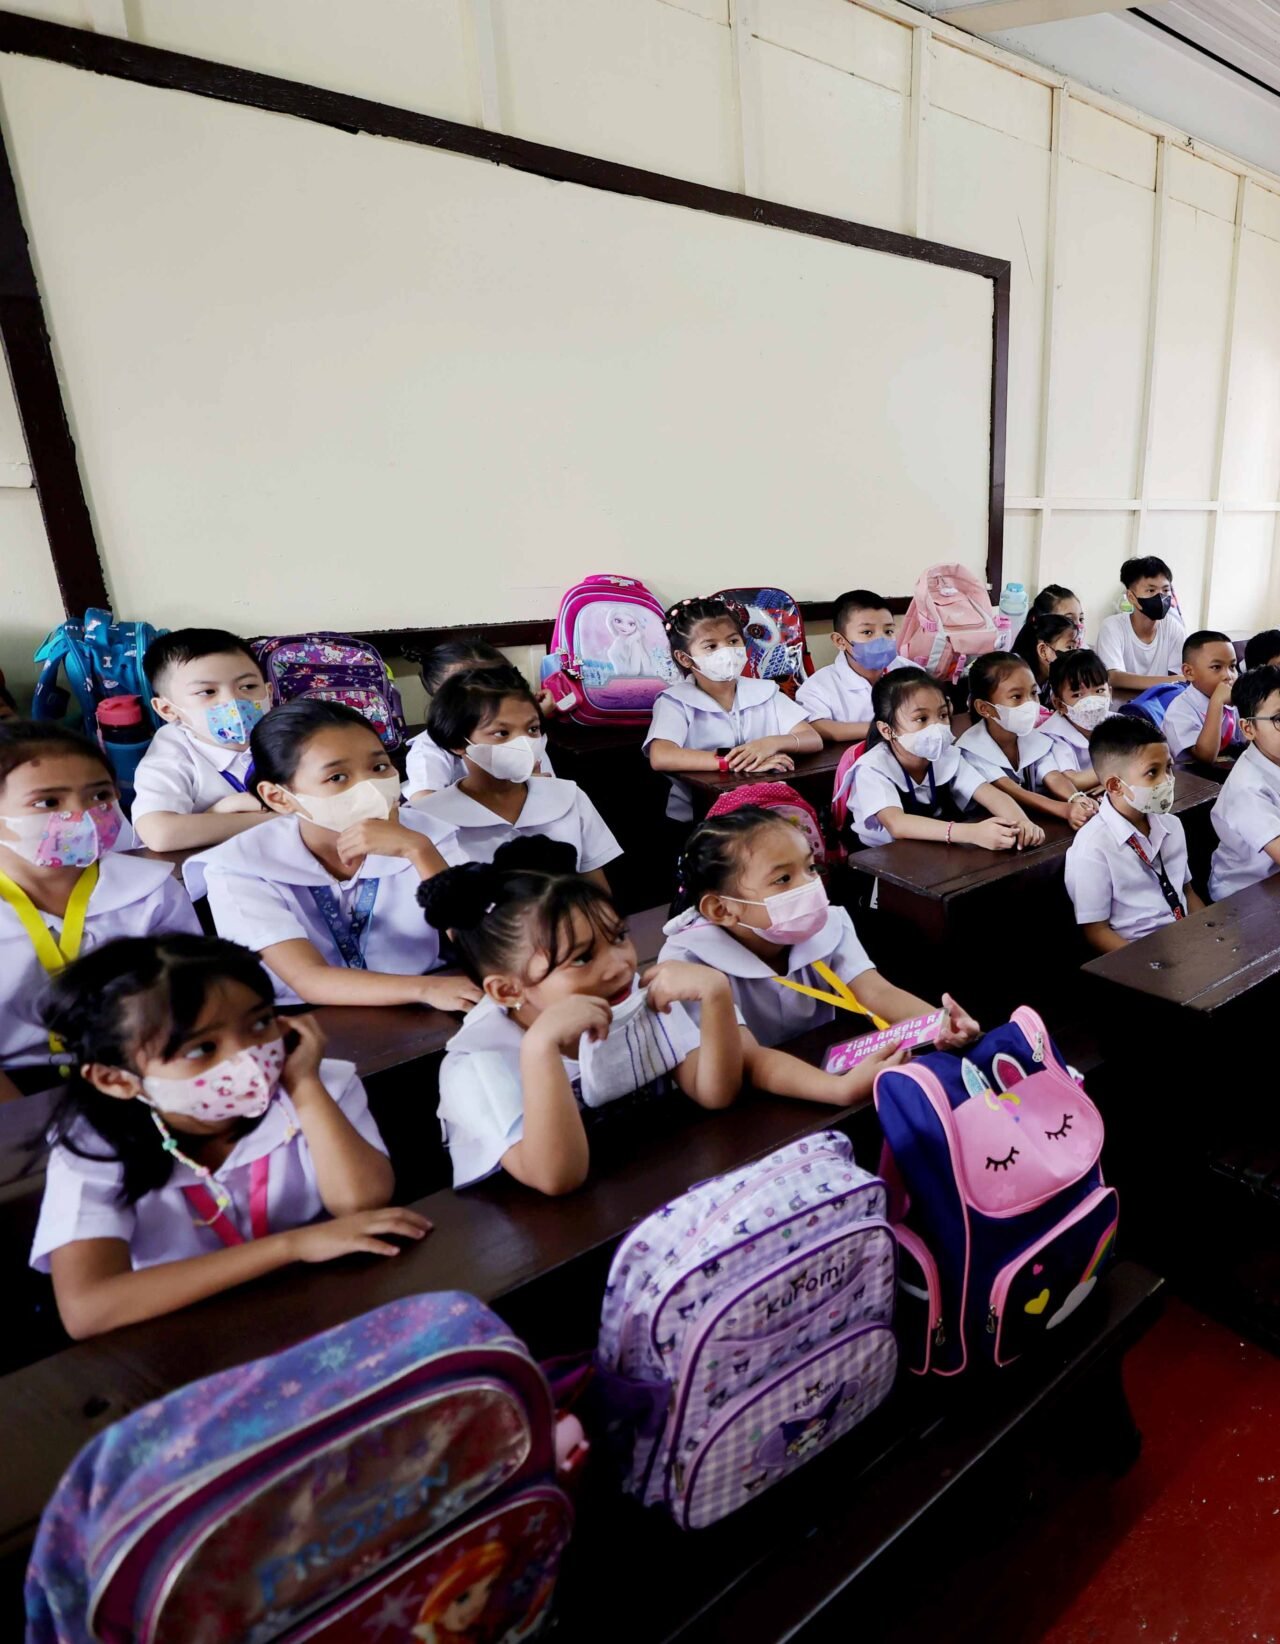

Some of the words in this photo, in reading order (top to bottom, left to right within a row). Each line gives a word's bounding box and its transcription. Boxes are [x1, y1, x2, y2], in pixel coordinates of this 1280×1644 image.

[844, 1034, 873, 1053] Ziah
[876, 1019, 922, 1041] Angela
[854, 1028, 921, 1058] Anasias
[256, 1461, 450, 1606] FROZEN
